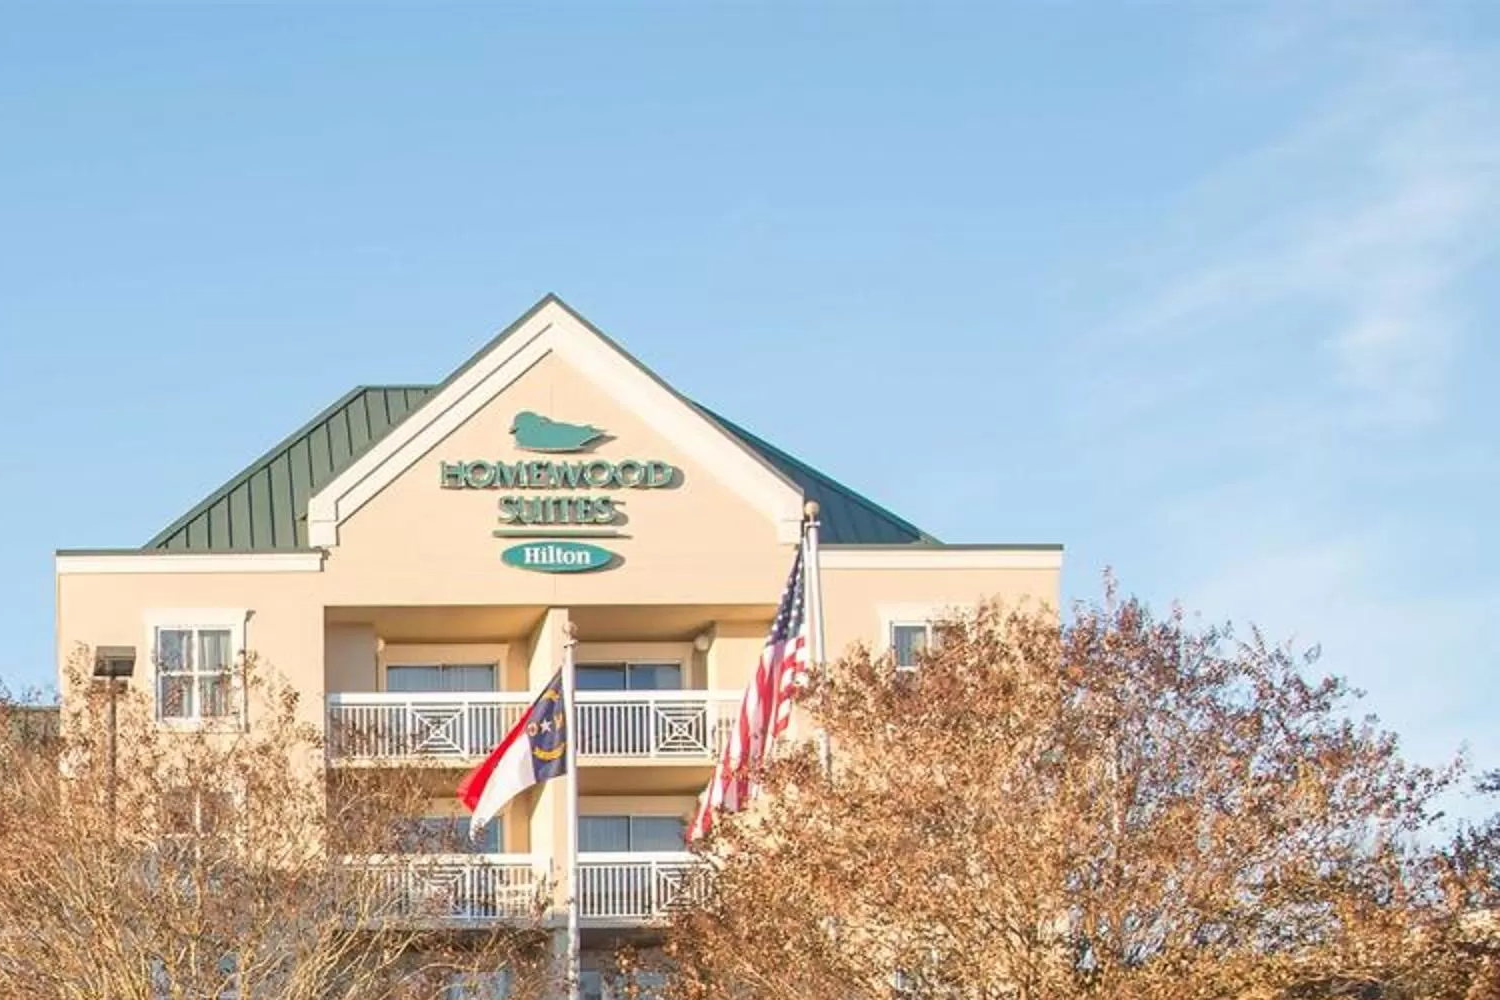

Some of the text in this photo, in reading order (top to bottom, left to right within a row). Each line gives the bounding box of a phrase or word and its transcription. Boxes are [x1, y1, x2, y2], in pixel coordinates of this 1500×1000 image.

[440, 460, 673, 488] HOMEWOOD
[498, 496, 614, 524] SUITES
[524, 546, 591, 565] Hilton
